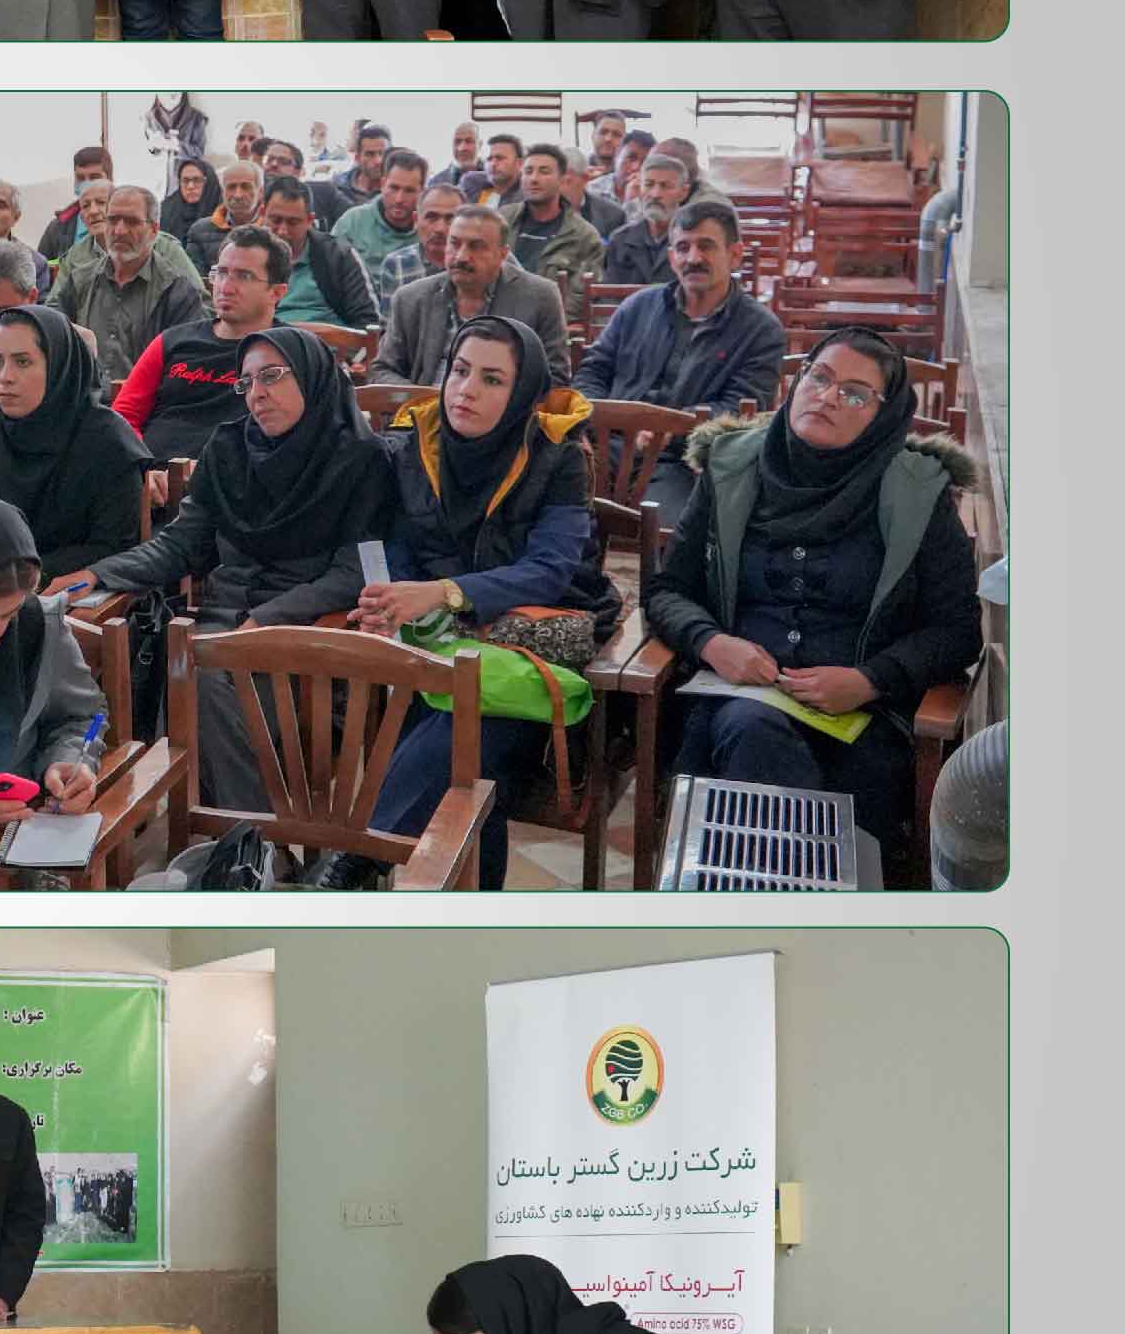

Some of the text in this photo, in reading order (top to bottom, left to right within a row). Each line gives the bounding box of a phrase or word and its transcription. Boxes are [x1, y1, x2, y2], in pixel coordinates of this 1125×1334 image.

[497, 1147, 756, 1186] شرکت زرین گستر باستان
[494, 1199, 759, 1224] تولیدکننده و واردکننده نهاده های کشاورزی
[571, 1270, 656, 1299] آمینواسی
[637, 1318, 668, 1330] Amino
[669, 1318, 690, 1330] acid
[712, 1318, 737, 1330] WSG
